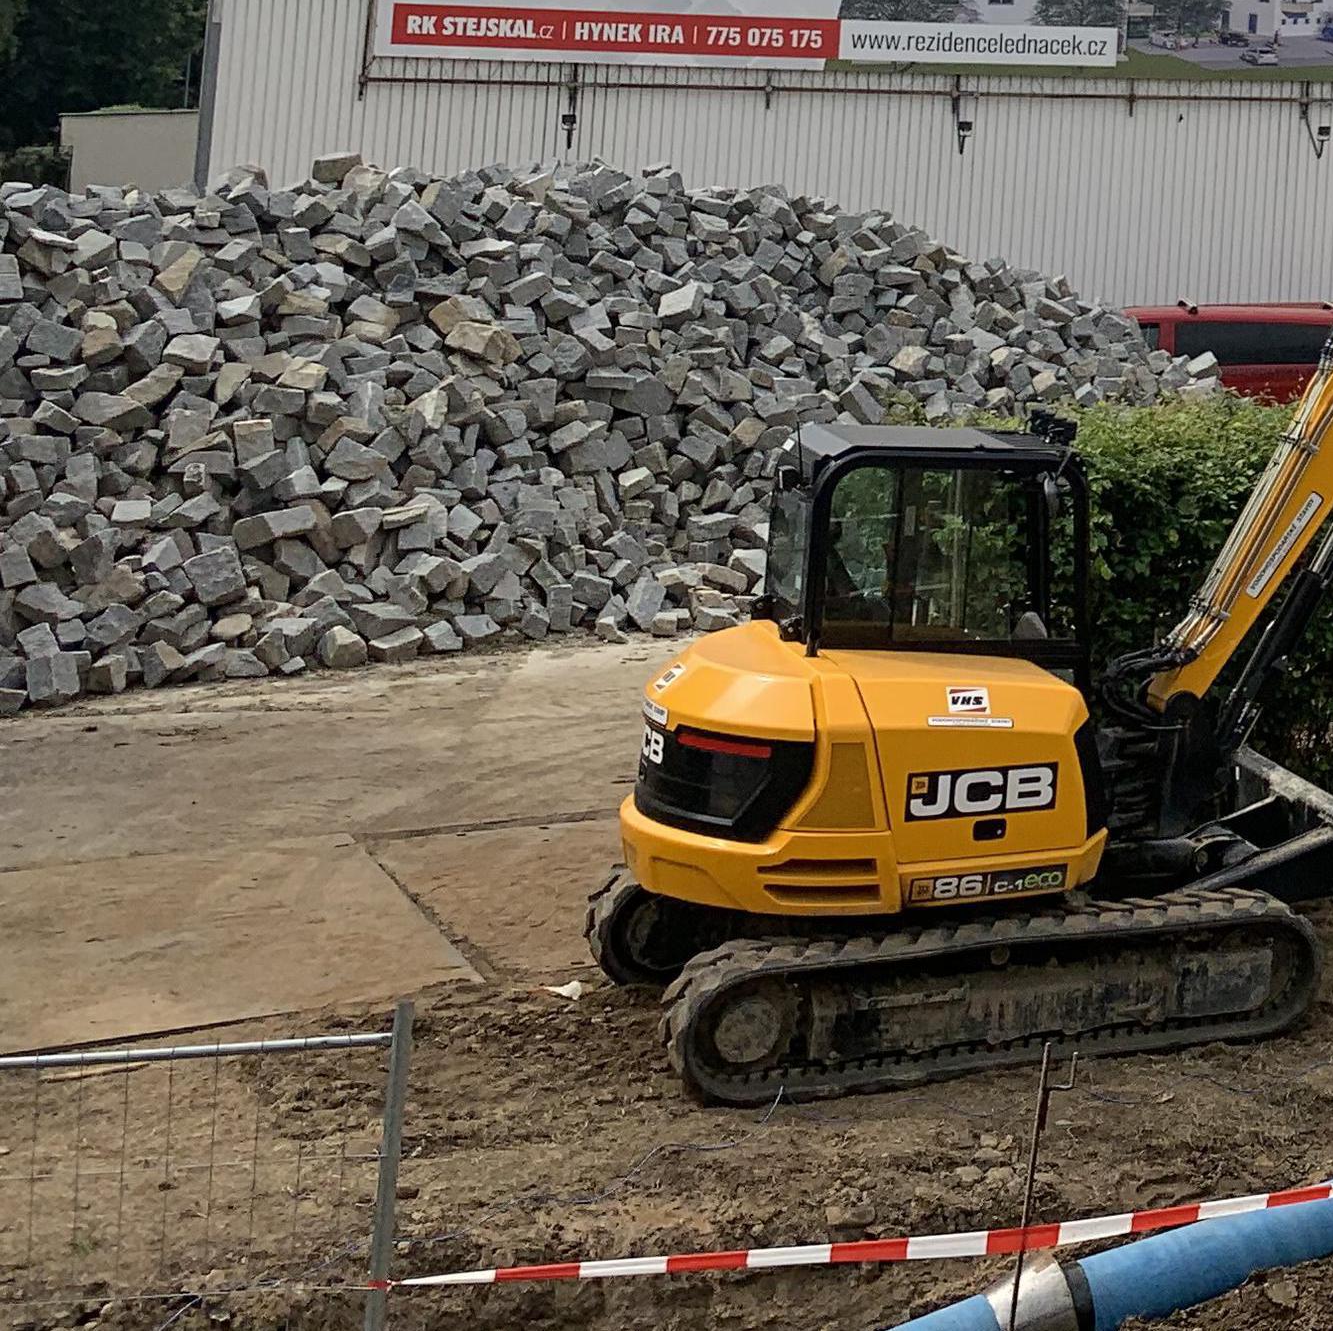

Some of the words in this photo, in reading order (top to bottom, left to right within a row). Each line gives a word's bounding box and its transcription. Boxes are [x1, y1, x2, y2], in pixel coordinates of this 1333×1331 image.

[407, 15, 437, 34] RK
[442, 16, 554, 40] STEJSKAL.cz
[574, 22, 642, 42] HYNEK
[648, 24, 684, 44] IRA
[706, 26, 742, 46] 775
[748, 28, 784, 47] 075
[789, 28, 823, 48] 175
[852, 32, 1108, 56] www.rezidencelednacek.cz
[951, 696, 984, 706] VHS
[910, 766, 1054, 817] JCB
[934, 874, 984, 899] 86
